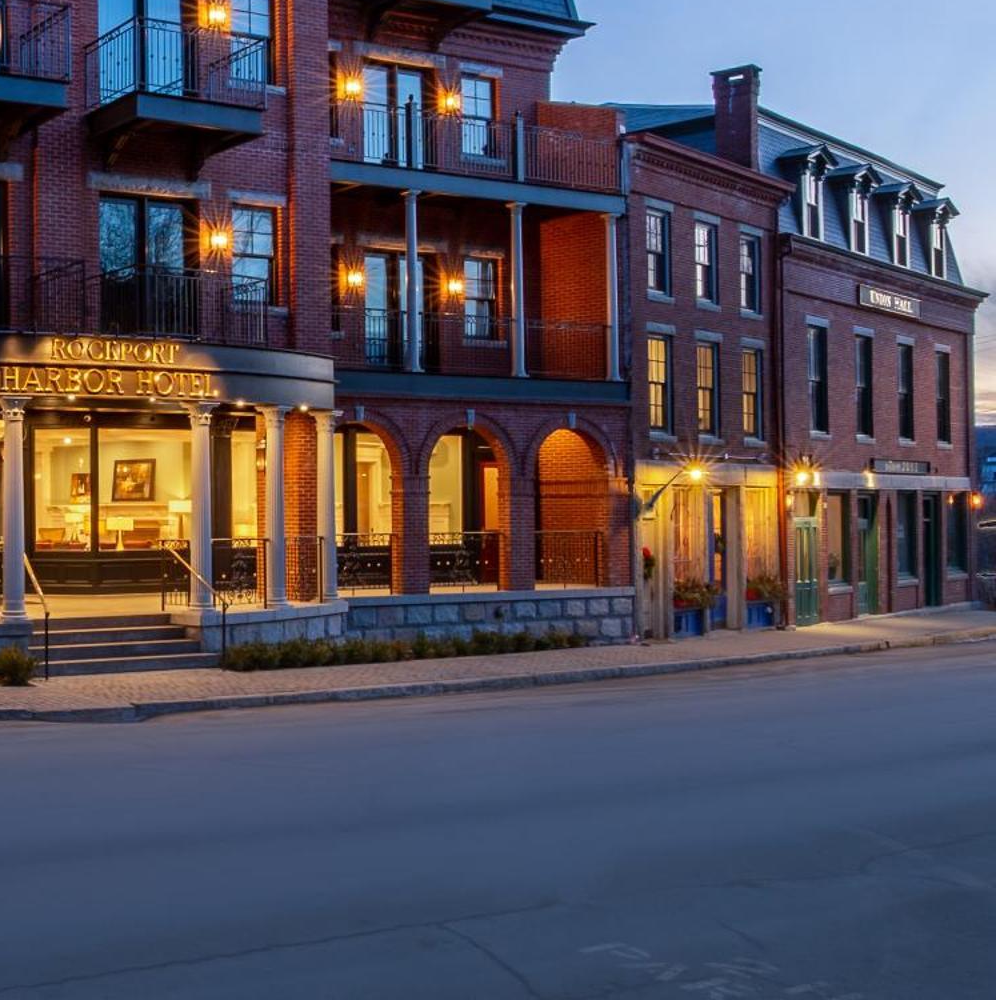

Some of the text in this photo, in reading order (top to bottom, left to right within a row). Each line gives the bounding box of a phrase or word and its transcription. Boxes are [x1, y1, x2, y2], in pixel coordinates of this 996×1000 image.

[50, 338, 181, 365] ROCKPORT
[0, 367, 220, 398] HARBOR HOTEL
